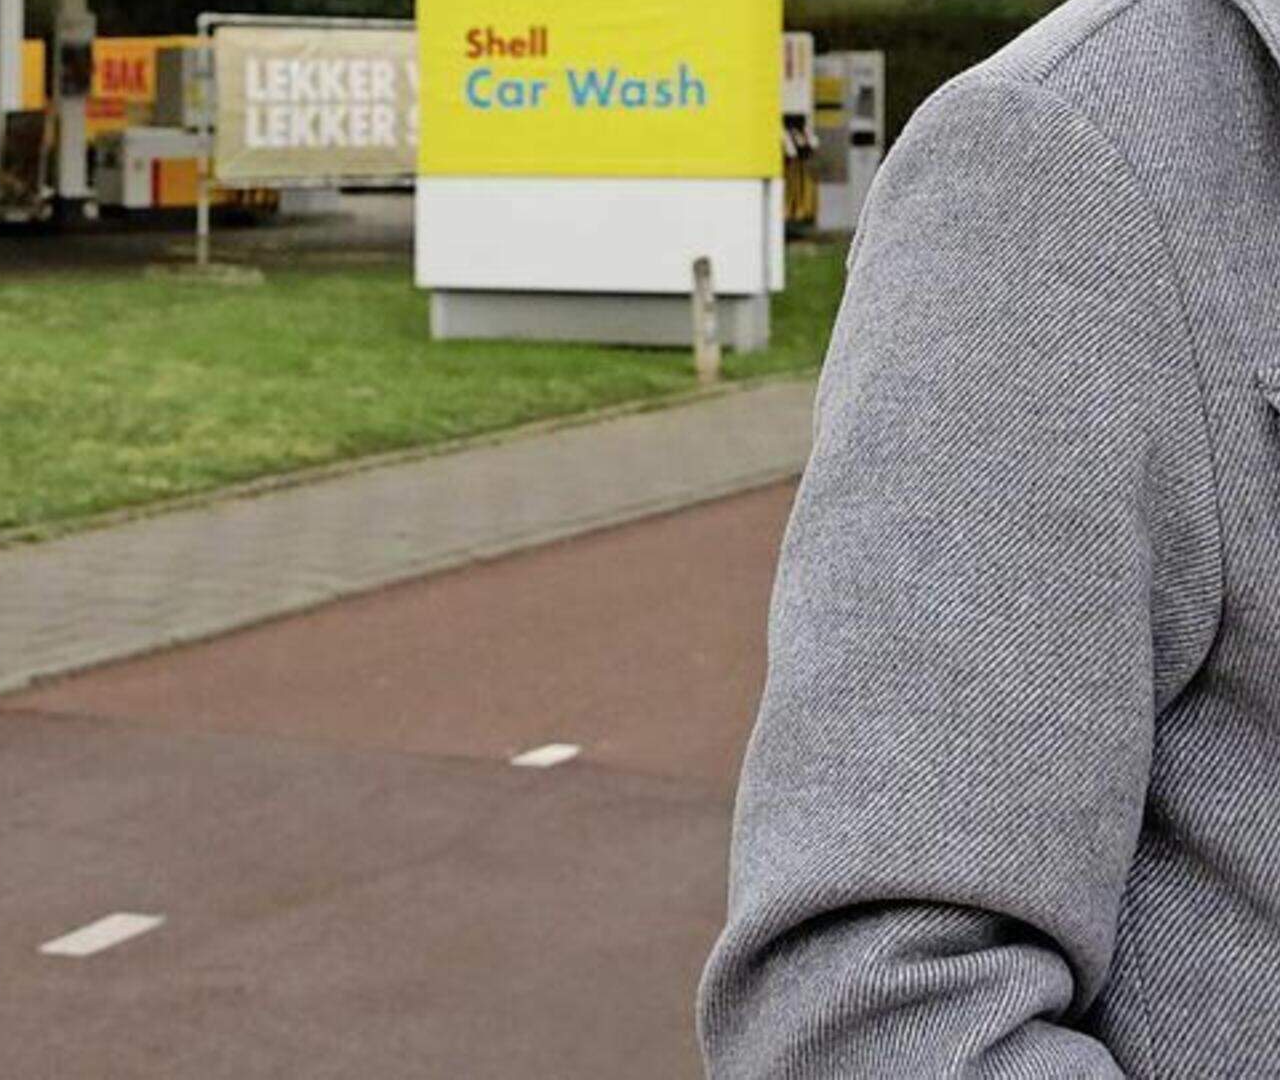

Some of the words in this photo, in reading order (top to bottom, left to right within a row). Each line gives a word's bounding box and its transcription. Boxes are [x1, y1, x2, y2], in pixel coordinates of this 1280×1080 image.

[465, 26, 549, 59] Shell
[245, 56, 398, 102] LEKKER
[465, 68, 549, 109] Car
[567, 64, 707, 108] Wash
[245, 103, 399, 148] LEKKER
